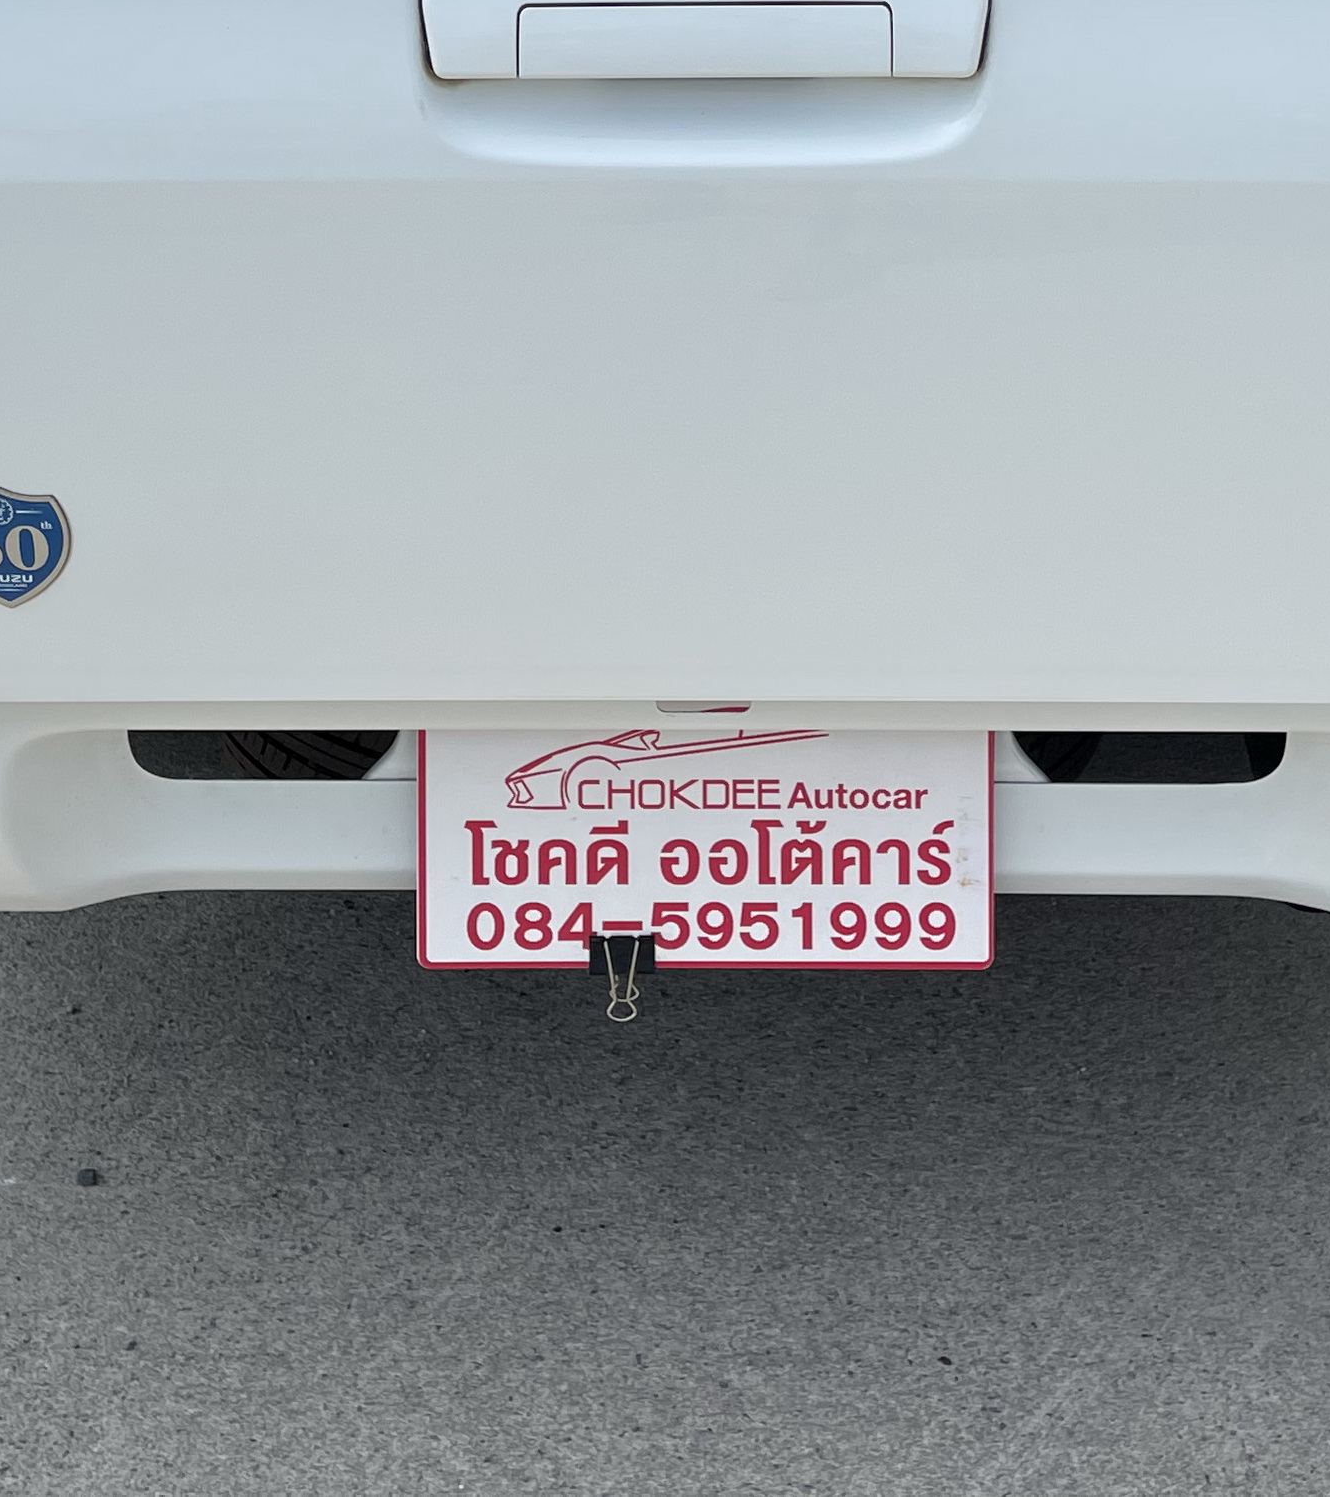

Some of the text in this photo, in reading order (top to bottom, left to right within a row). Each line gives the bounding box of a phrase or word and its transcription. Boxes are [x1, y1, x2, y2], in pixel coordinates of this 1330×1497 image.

[577, 779, 928, 810] CHOKDEE Autocar
[464, 818, 955, 887] โชคดี ออโต้คาร์
[466, 900, 957, 952] 084-5951999
